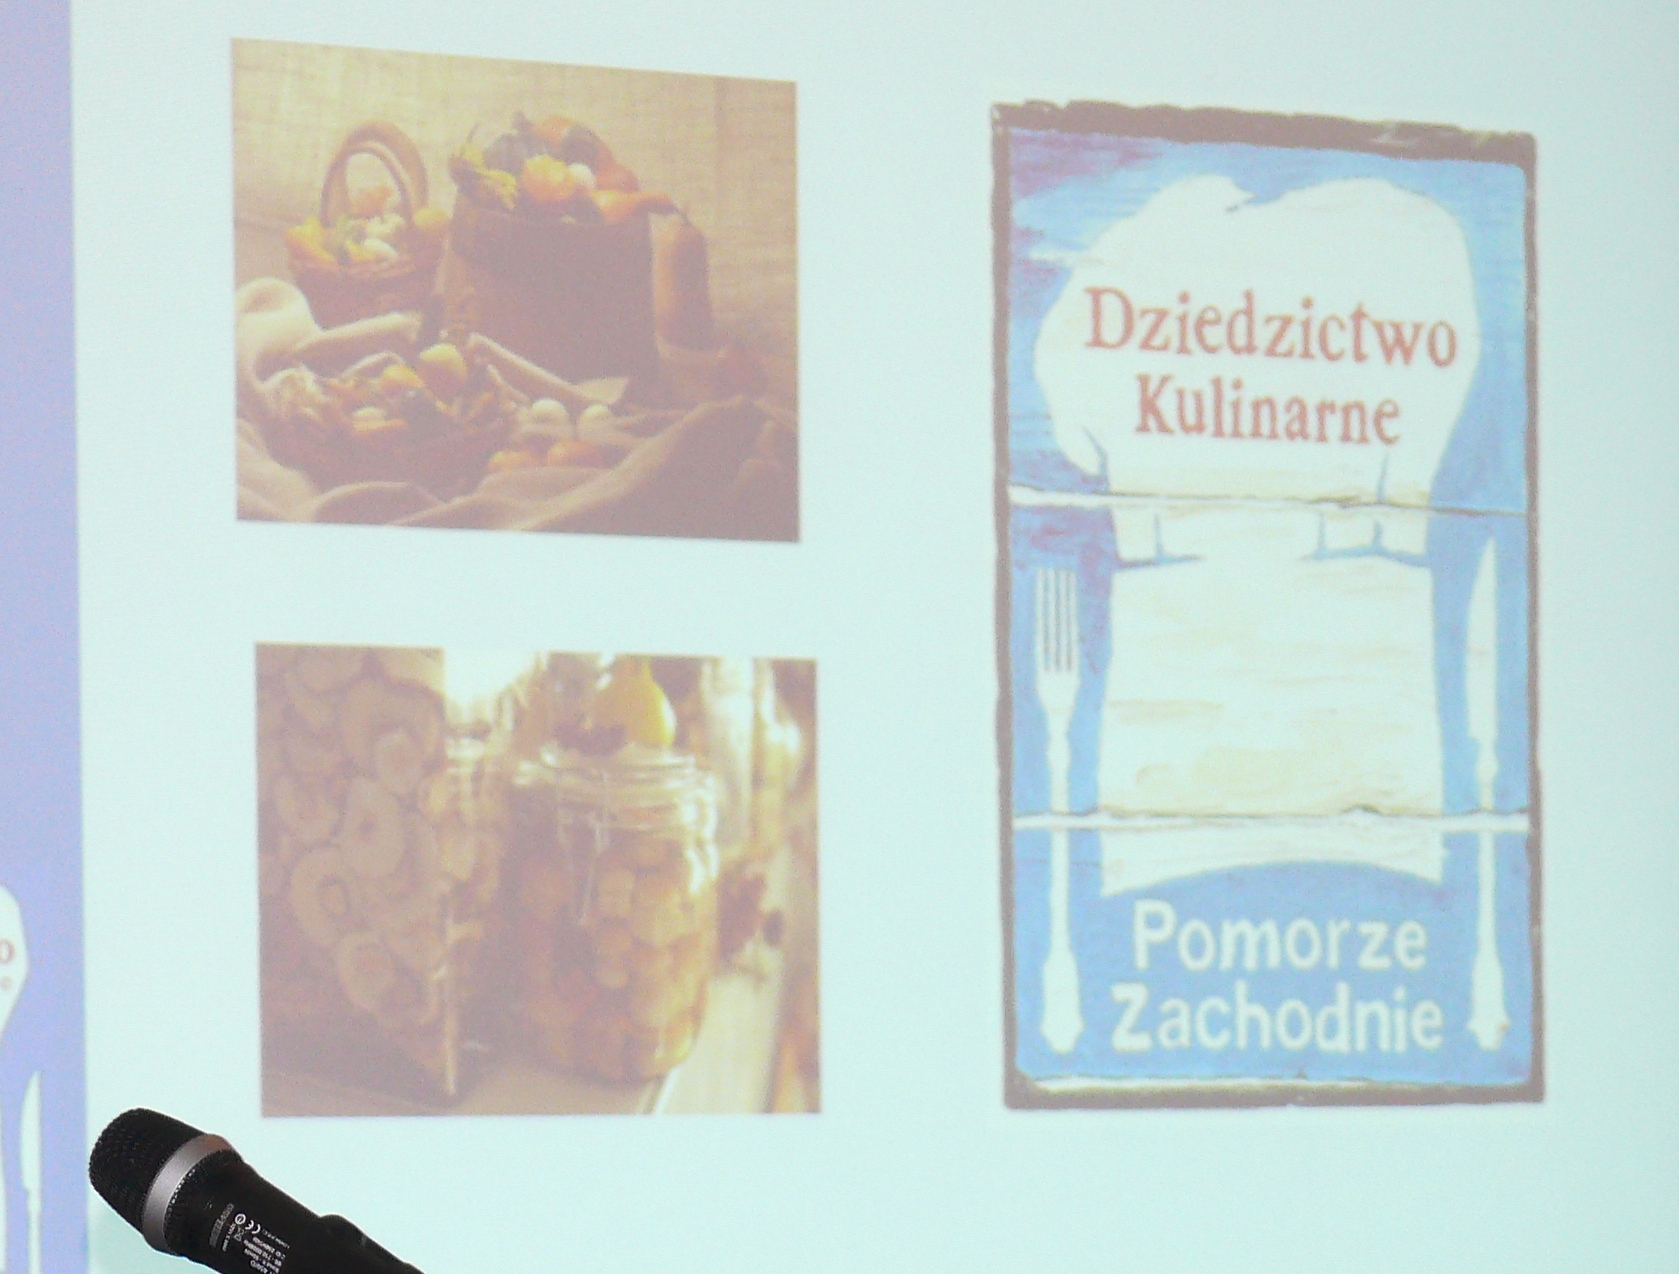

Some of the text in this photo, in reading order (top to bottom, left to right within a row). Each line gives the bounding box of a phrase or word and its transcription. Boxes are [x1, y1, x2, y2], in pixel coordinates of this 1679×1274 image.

[1083, 285, 1458, 368] Dziedzictwo
[1134, 372, 1402, 446] Kulinarne
[1132, 899, 1428, 973] Pomorze
[1110, 978, 1444, 1052] Zachodnie
